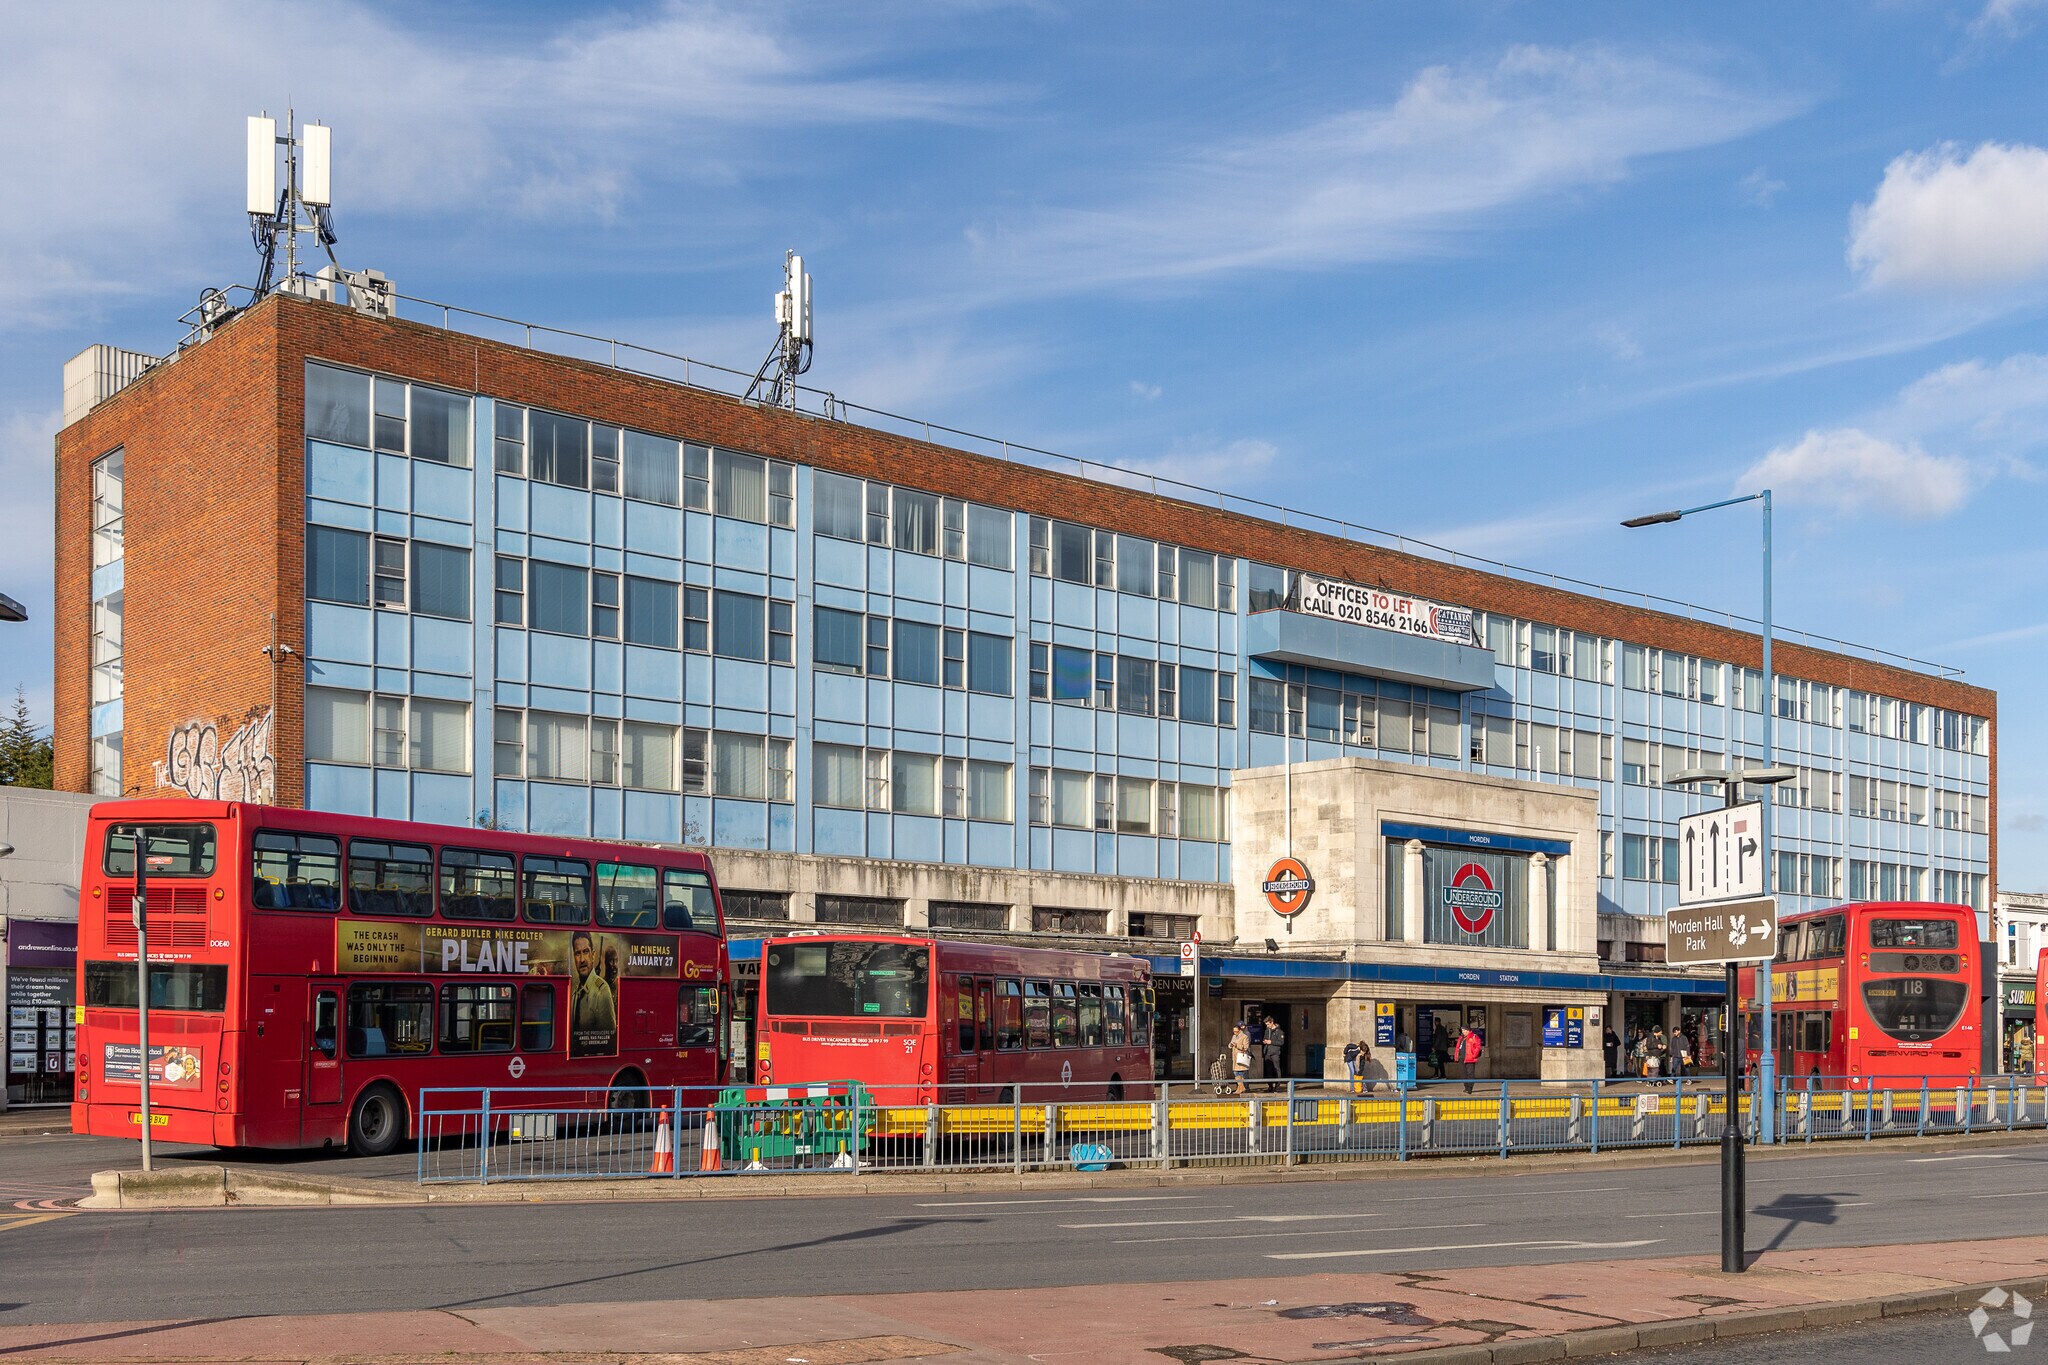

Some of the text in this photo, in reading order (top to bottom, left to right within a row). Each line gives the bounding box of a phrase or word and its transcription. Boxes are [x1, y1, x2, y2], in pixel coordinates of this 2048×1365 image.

[1317, 582, 1413, 614] OFFICES TO LET
[1304, 597, 1428, 634] CALL 020 8546 2166
[1444, 888, 1501, 907] UNDERGROUND
[1669, 915, 1723, 934] Morden Hall
[354, 931, 398, 940] THE CRASH
[426, 928, 544, 941] GERARD BUTLER MIKE COLTER
[347, 942, 405, 952] WAS ONLY THE
[631, 945, 670, 955] IN CINEMAS
[1686, 936, 1706, 951] Park
[354, 954, 398, 964] BEGINNING
[442, 939, 529, 972] PLANE
[628, 955, 673, 967] JANUARY 27
[1904, 980, 1923, 994] 118
[2008, 990, 2036, 1004] SUBWA
[154, 1116, 166, 1124] BXJ
